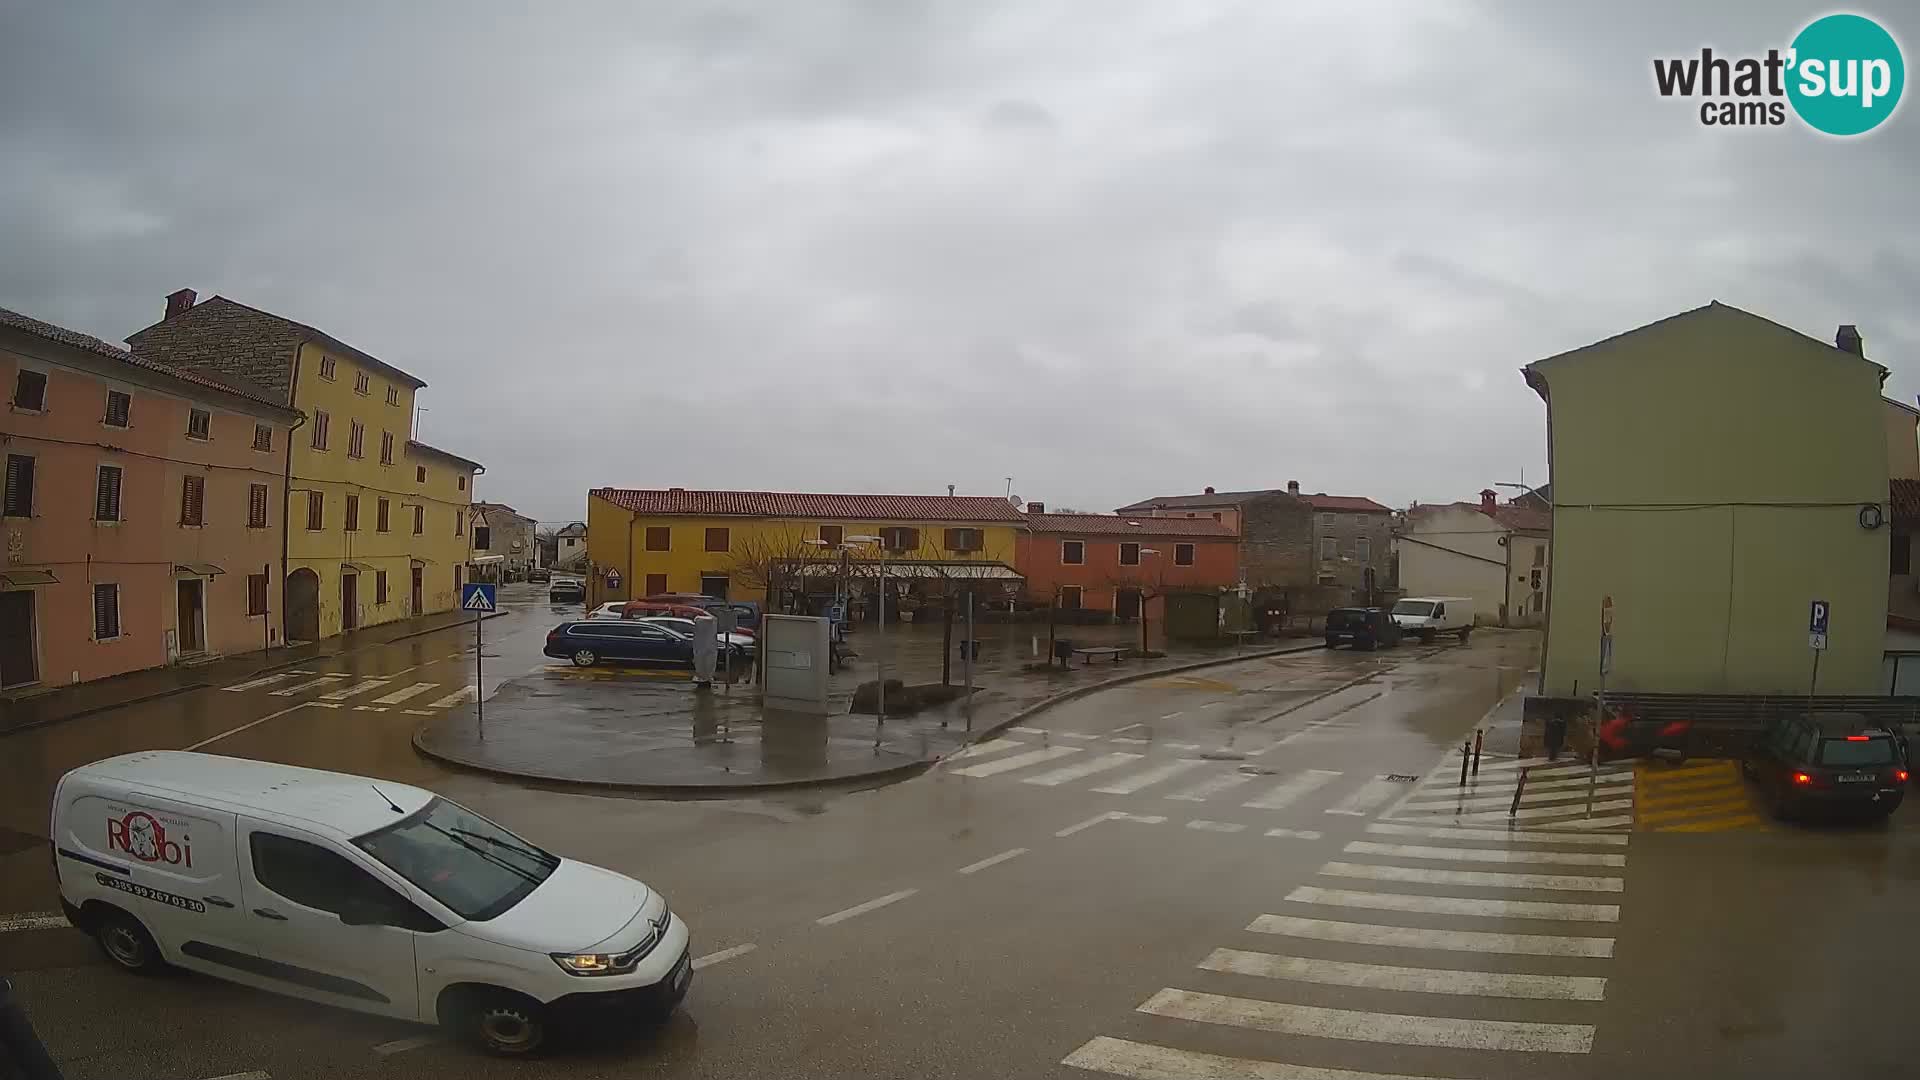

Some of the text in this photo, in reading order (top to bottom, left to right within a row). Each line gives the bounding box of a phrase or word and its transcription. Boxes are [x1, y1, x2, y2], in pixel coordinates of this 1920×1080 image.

[1813, 603, 1825, 626] P
[134, 885, 148, 897] 99
[149, 890, 169, 903] 267
[172, 896, 186, 907] 03
[189, 901, 203, 912] 30
